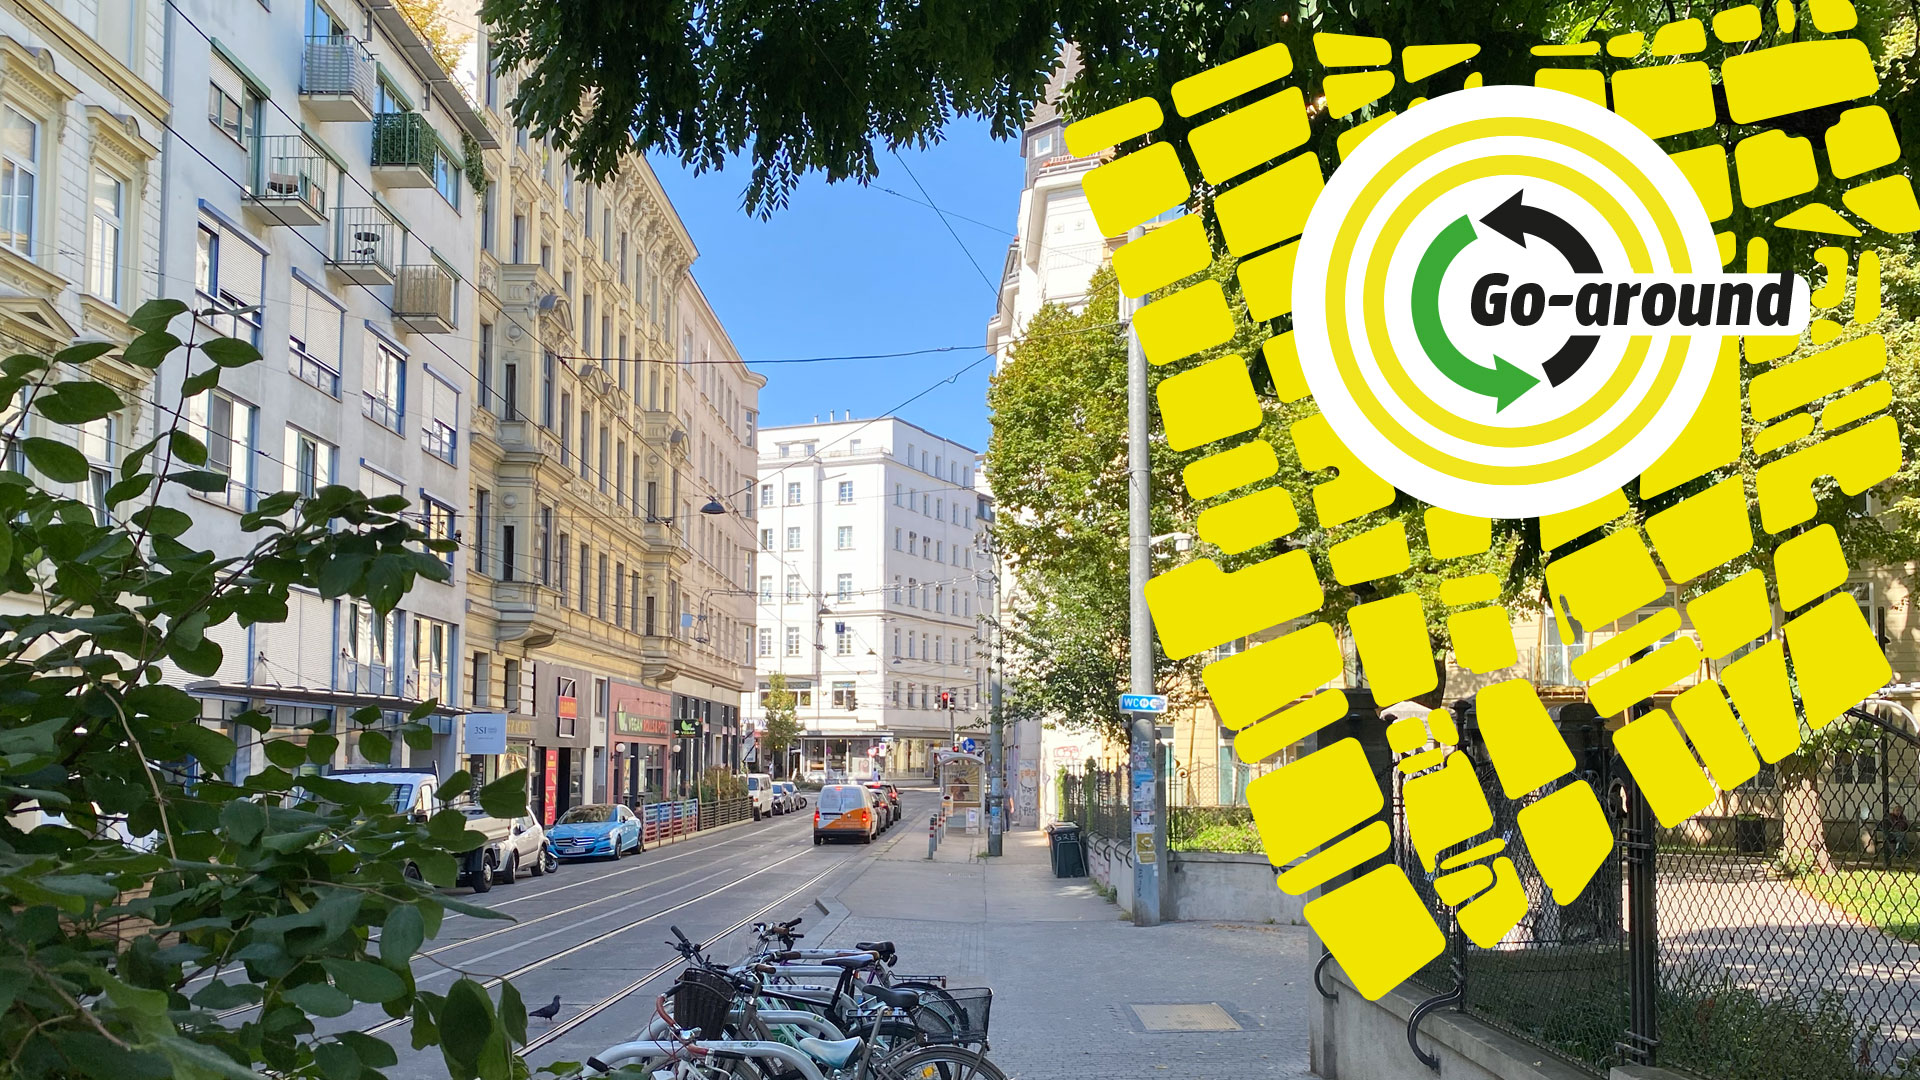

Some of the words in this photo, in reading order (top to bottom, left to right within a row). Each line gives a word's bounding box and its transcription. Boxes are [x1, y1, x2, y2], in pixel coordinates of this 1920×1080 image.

[1124, 698, 1139, 708] WC
[628, 716, 642, 732] VEGAN
[474, 726, 487, 735] 3SI
